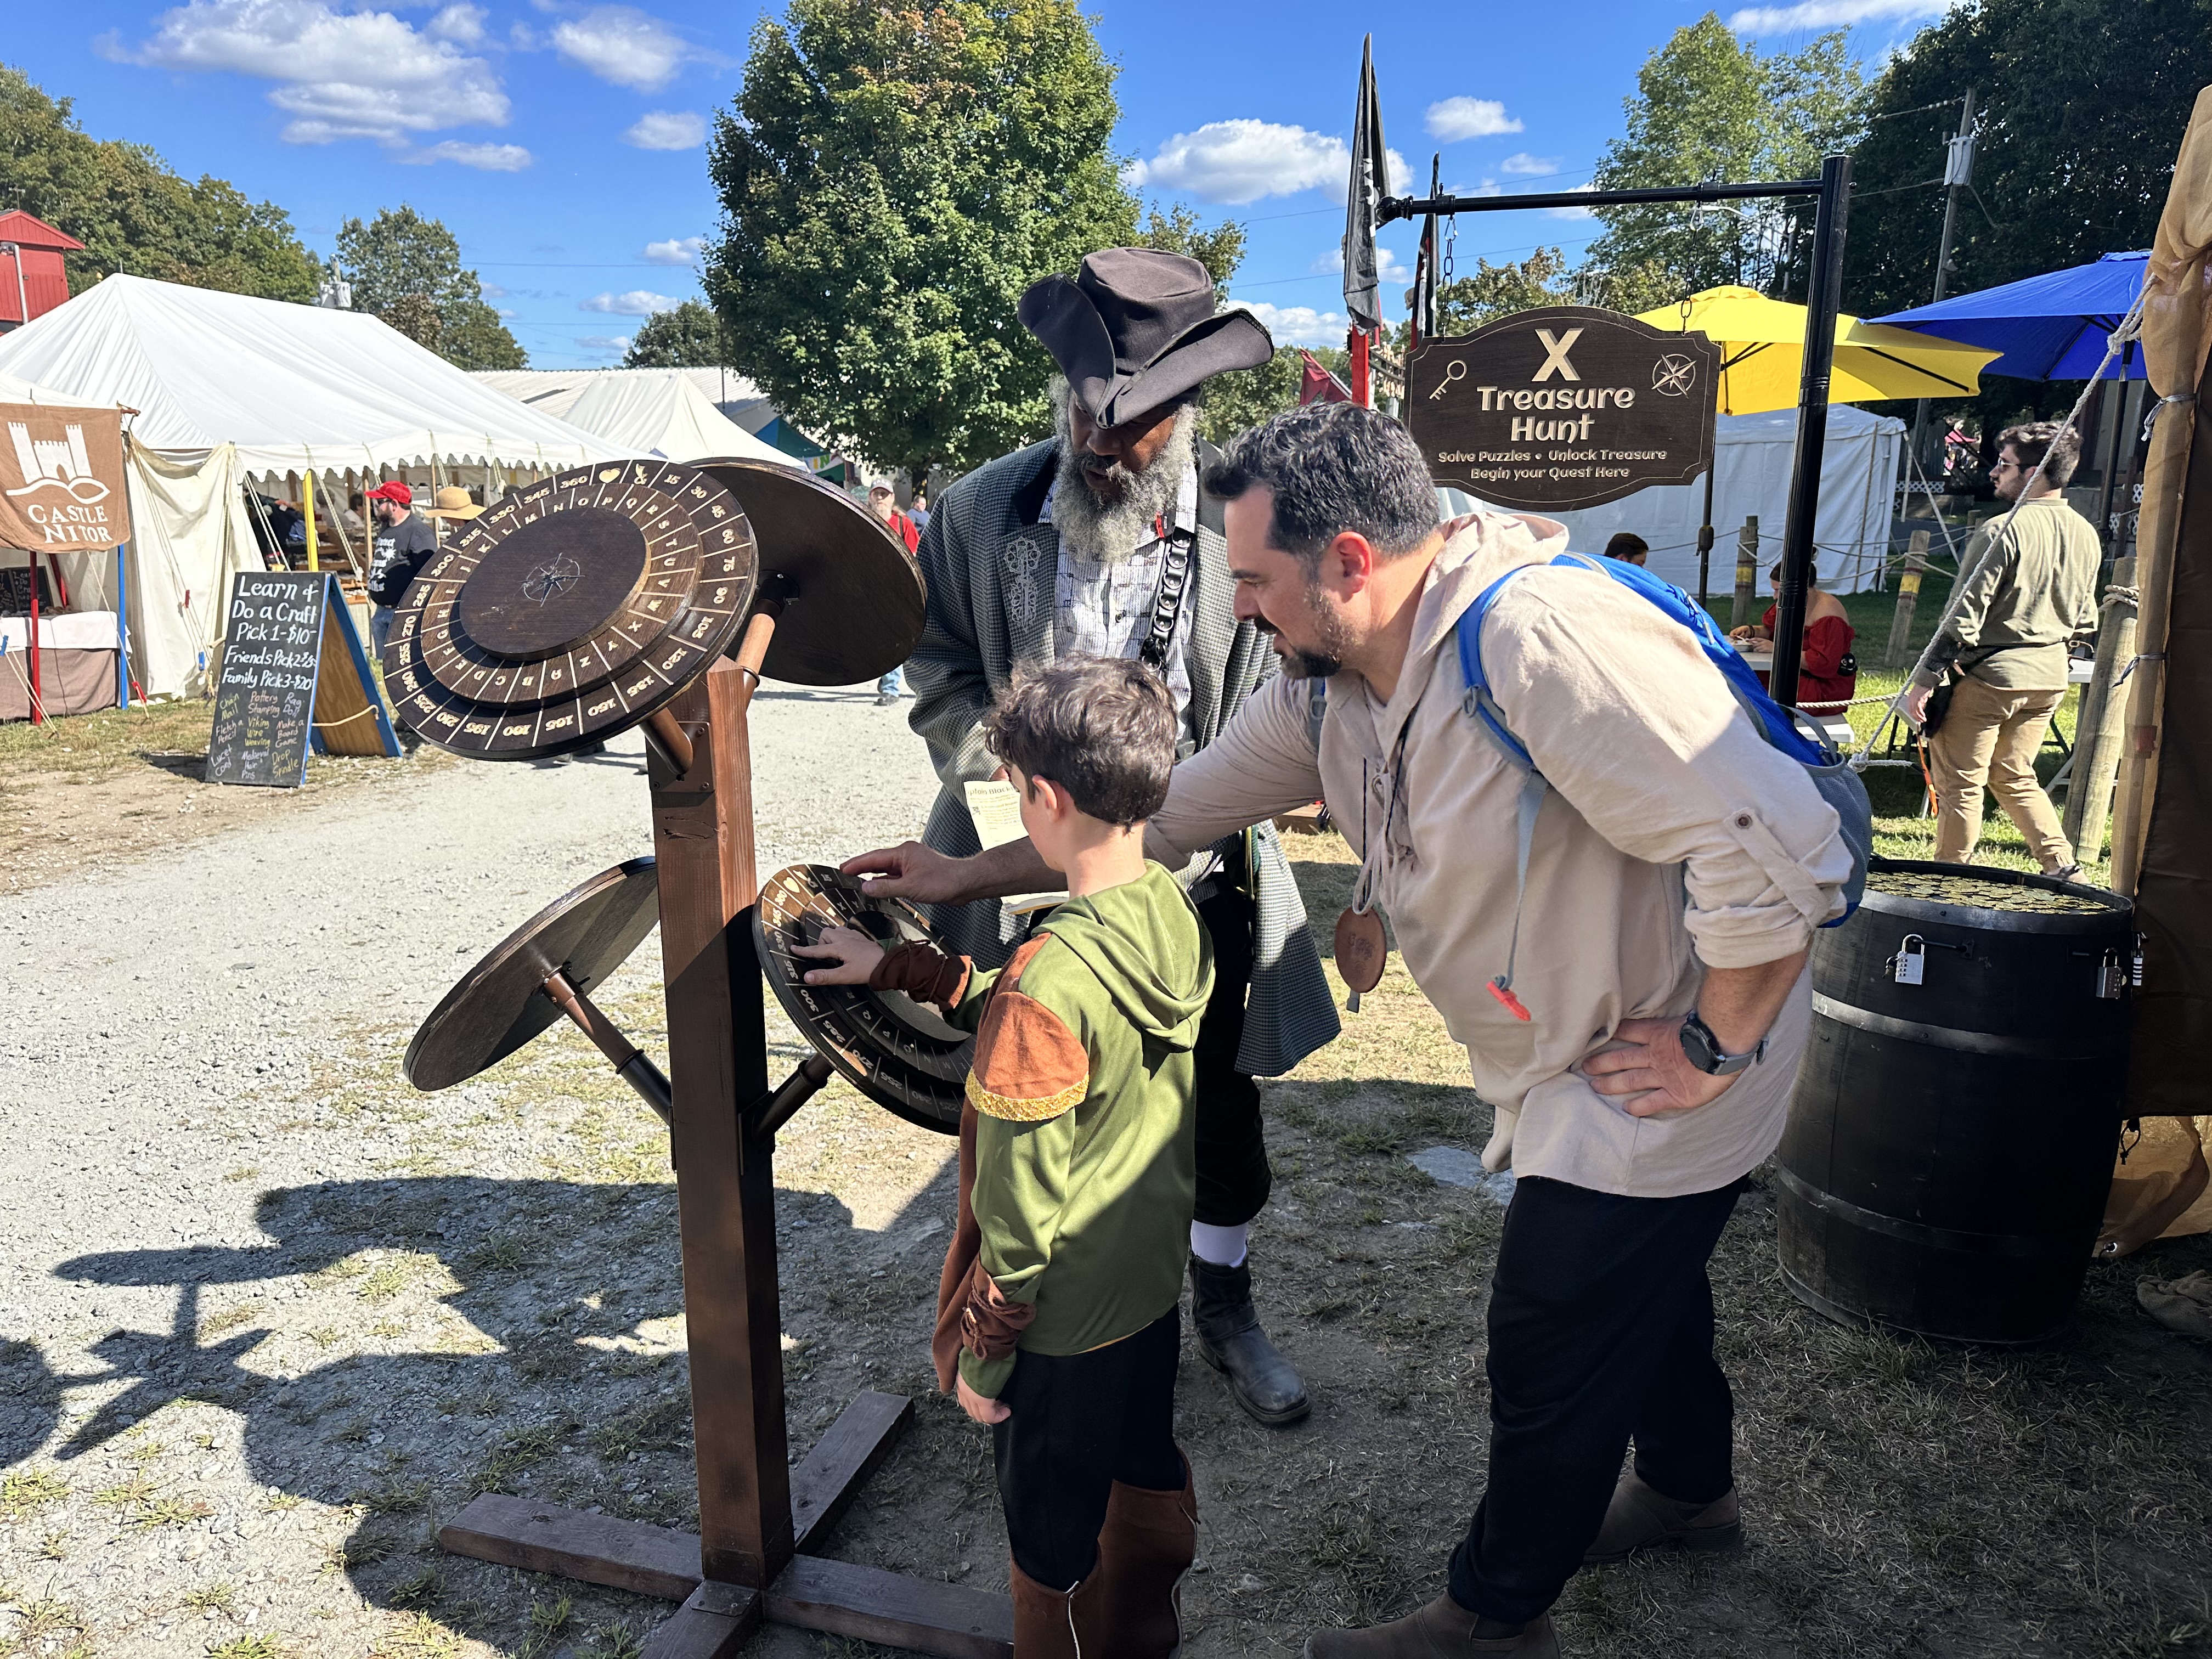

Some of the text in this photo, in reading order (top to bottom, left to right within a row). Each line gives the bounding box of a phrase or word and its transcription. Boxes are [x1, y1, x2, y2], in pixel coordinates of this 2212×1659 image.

[1531, 328, 1585, 382] X
[1477, 386, 1636, 411] Treasure
[1510, 413, 1595, 444] Hunt
[1437, 448, 1667, 464] Solve Puzzles Unlock Treasure
[664, 474, 681, 484] 15
[1470, 466, 1630, 482] Begin your Quest Here
[560, 476, 588, 488] 360
[691, 486, 708, 499] 30
[554, 503, 564, 512] N
[578, 497, 589, 506] O
[602, 496, 613, 505] P
[626, 497, 638, 509] Q
[28, 504, 108, 523] CASTLE
[646, 504, 659, 515] R
[712, 505, 726, 518] 45
[524, 514, 538, 524] M
[658, 520, 670, 530] S
[43, 524, 112, 543] NITOR
[459, 528, 482, 547] 315
[722, 528, 735, 544] 60
[478, 544, 491, 553] K
[665, 538, 678, 547] T
[664, 557, 676, 567] U
[723, 556, 735, 572] 75
[238, 575, 298, 600] Learn
[658, 578, 671, 588] V
[713, 586, 728, 604] 90
[232, 600, 317, 624] Do a Craft
[437, 608, 450, 618] H
[647, 600, 663, 612] W
[236, 622, 268, 641] Pick
[402, 615, 416, 637] 270
[628, 620, 642, 632] X
[437, 629, 449, 639] G
[443, 647, 455, 656] F
[607, 640, 619, 651] Y
[224, 645, 273, 664] Friends
[273, 649, 294, 668] Pick
[399, 643, 411, 665] 255
[662, 647, 687, 670] 120
[455, 659, 469, 670] E
[579, 656, 591, 668] Z
[222, 667, 258, 689] Family
[260, 669, 283, 687] Pick
[401, 670, 419, 692] 240
[473, 670, 486, 680] D
[495, 676, 507, 686] C
[522, 676, 534, 686] B
[551, 669, 562, 680] A
[627, 675, 655, 697] 135
[219, 693, 240, 709] Chain
[250, 690, 302, 708] Pottery Rag
[413, 693, 437, 713] 225
[222, 702, 238, 721] Mail
[248, 703, 300, 718] Stamping Doll
[588, 698, 617, 716] 150
[248, 716, 269, 729] Viking
[276, 718, 296, 730] Make
[436, 712, 460, 727] 210
[216, 720, 237, 736] Fletch
[218, 727, 236, 744] Pencil
[247, 729, 263, 737] Wire
[278, 725, 298, 739] Board
[463, 722, 492, 736] 195
[245, 738, 270, 748] Weaving
[275, 737, 297, 748] Game
[211, 743, 233, 767] Lucet
[272, 749, 290, 765] Drop
[215, 757, 232, 776] Cord
[273, 758, 299, 778] Spindle
[241, 769, 255, 780] Pins
[800, 989, 819, 1012] 300
[823, 1020, 846, 1042] 285
[853, 1049, 874, 1069] 270
